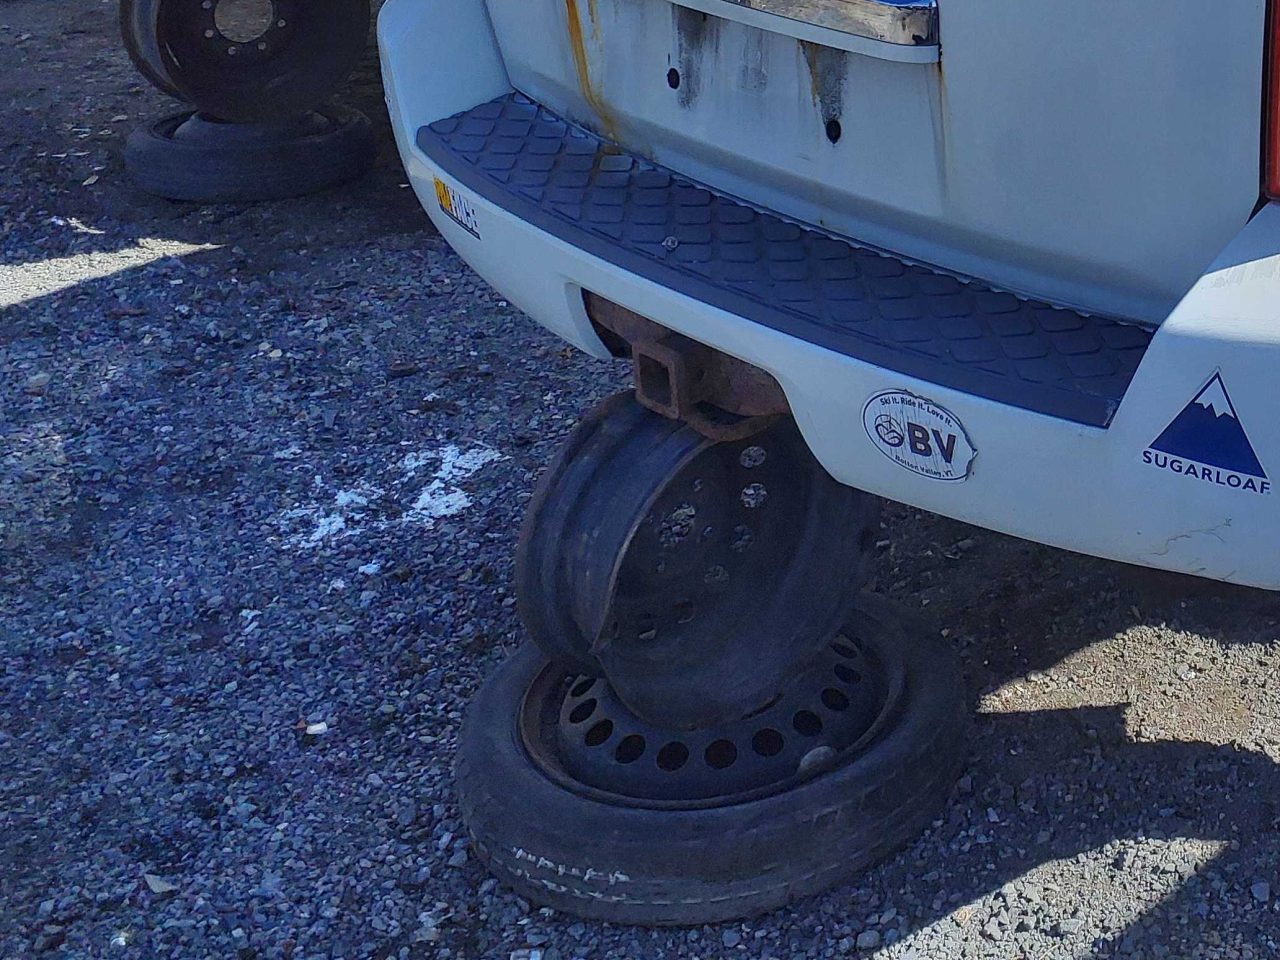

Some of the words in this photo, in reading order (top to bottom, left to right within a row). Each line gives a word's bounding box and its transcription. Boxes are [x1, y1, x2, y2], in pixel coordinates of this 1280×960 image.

[900, 396, 916, 408] Ride
[926, 405, 944, 421] Love
[907, 422, 957, 464] BV
[1142, 450, 1271, 494] SUGARLOAF
